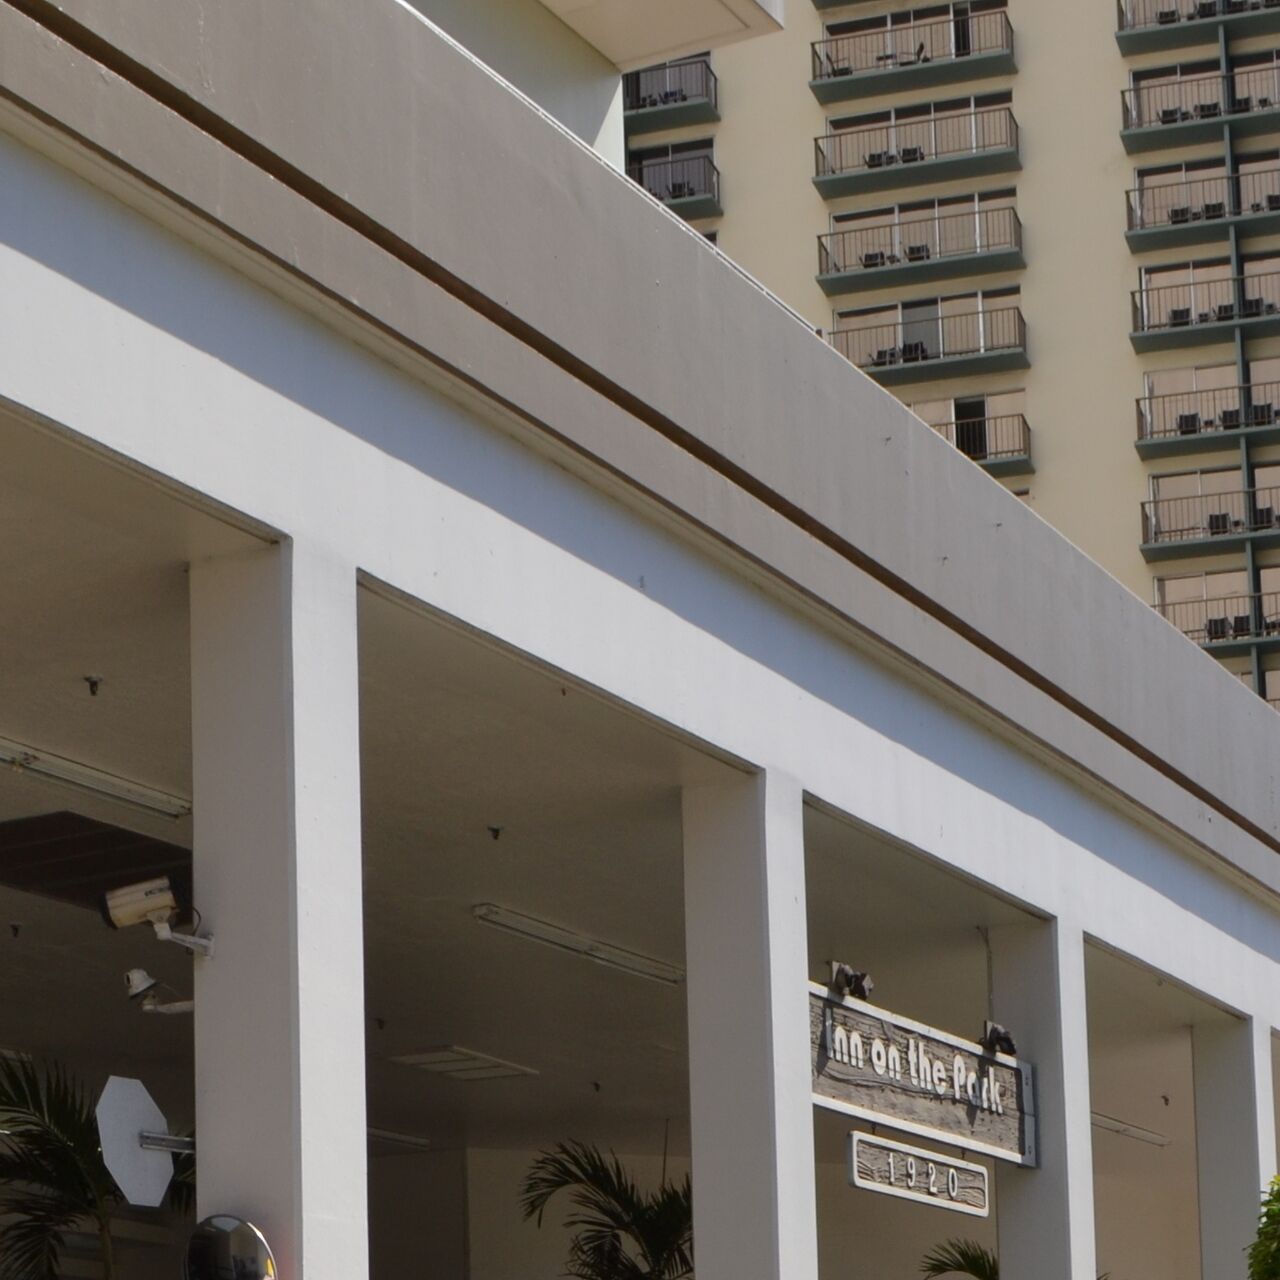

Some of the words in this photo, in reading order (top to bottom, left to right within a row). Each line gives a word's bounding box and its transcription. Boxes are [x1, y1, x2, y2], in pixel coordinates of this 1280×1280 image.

[826, 1008, 864, 1069] Inn
[871, 1038, 901, 1082] on
[908, 1038, 947, 1096] the
[952, 1054, 1004, 1115] Park
[888, 1152, 958, 1198] 1920
